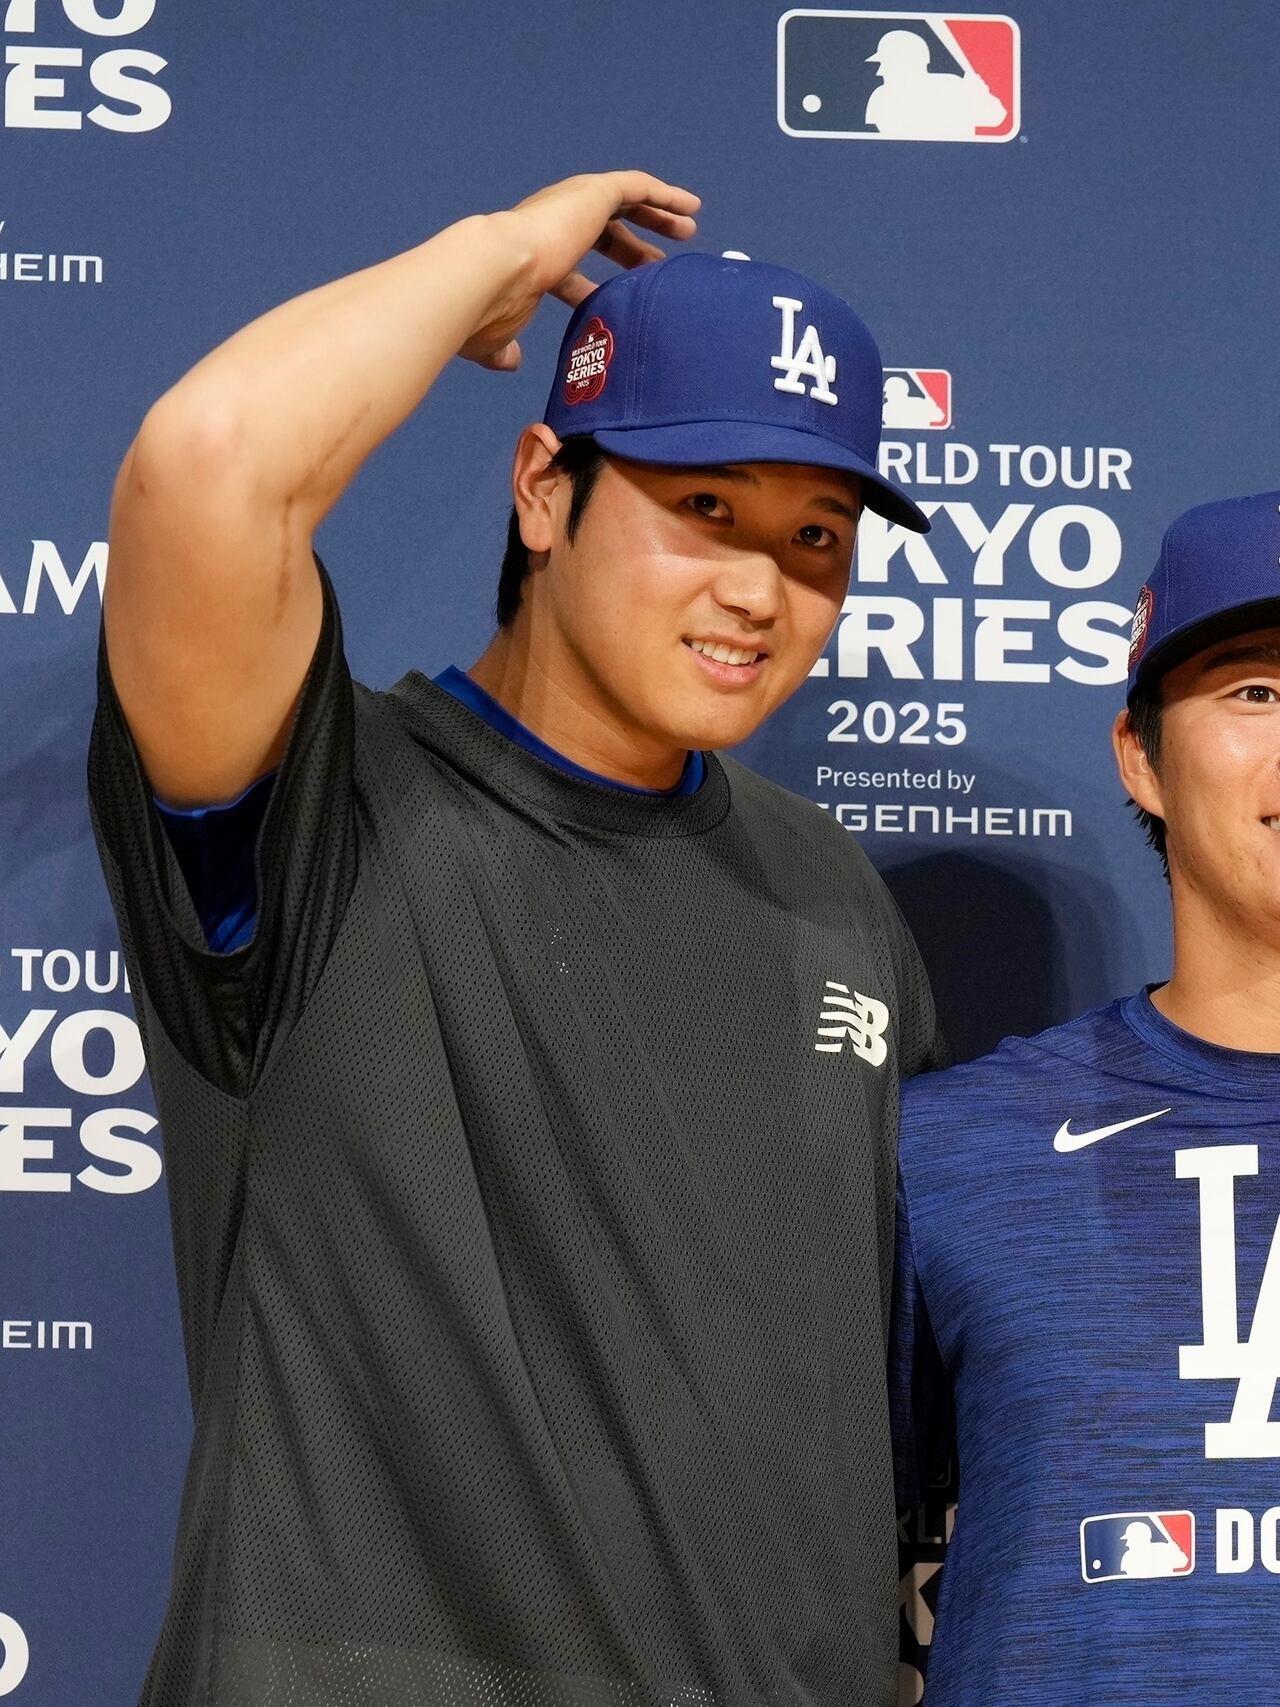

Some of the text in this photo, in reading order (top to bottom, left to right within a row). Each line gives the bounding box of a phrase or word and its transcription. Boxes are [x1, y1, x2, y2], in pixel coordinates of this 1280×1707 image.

[0, 254, 103, 283] EIM
[570, 347, 606, 370] TOKYO
[771, 296, 838, 405] LA
[566, 360, 606, 383] SERIES
[989, 444, 1133, 490] TOUR
[806, 595, 1134, 686] RIES
[827, 700, 967, 746] 2025
[817, 766, 976, 795] Presented by
[816, 803, 1072, 837] GENHEIM
[12, 948, 131, 994] TOU
